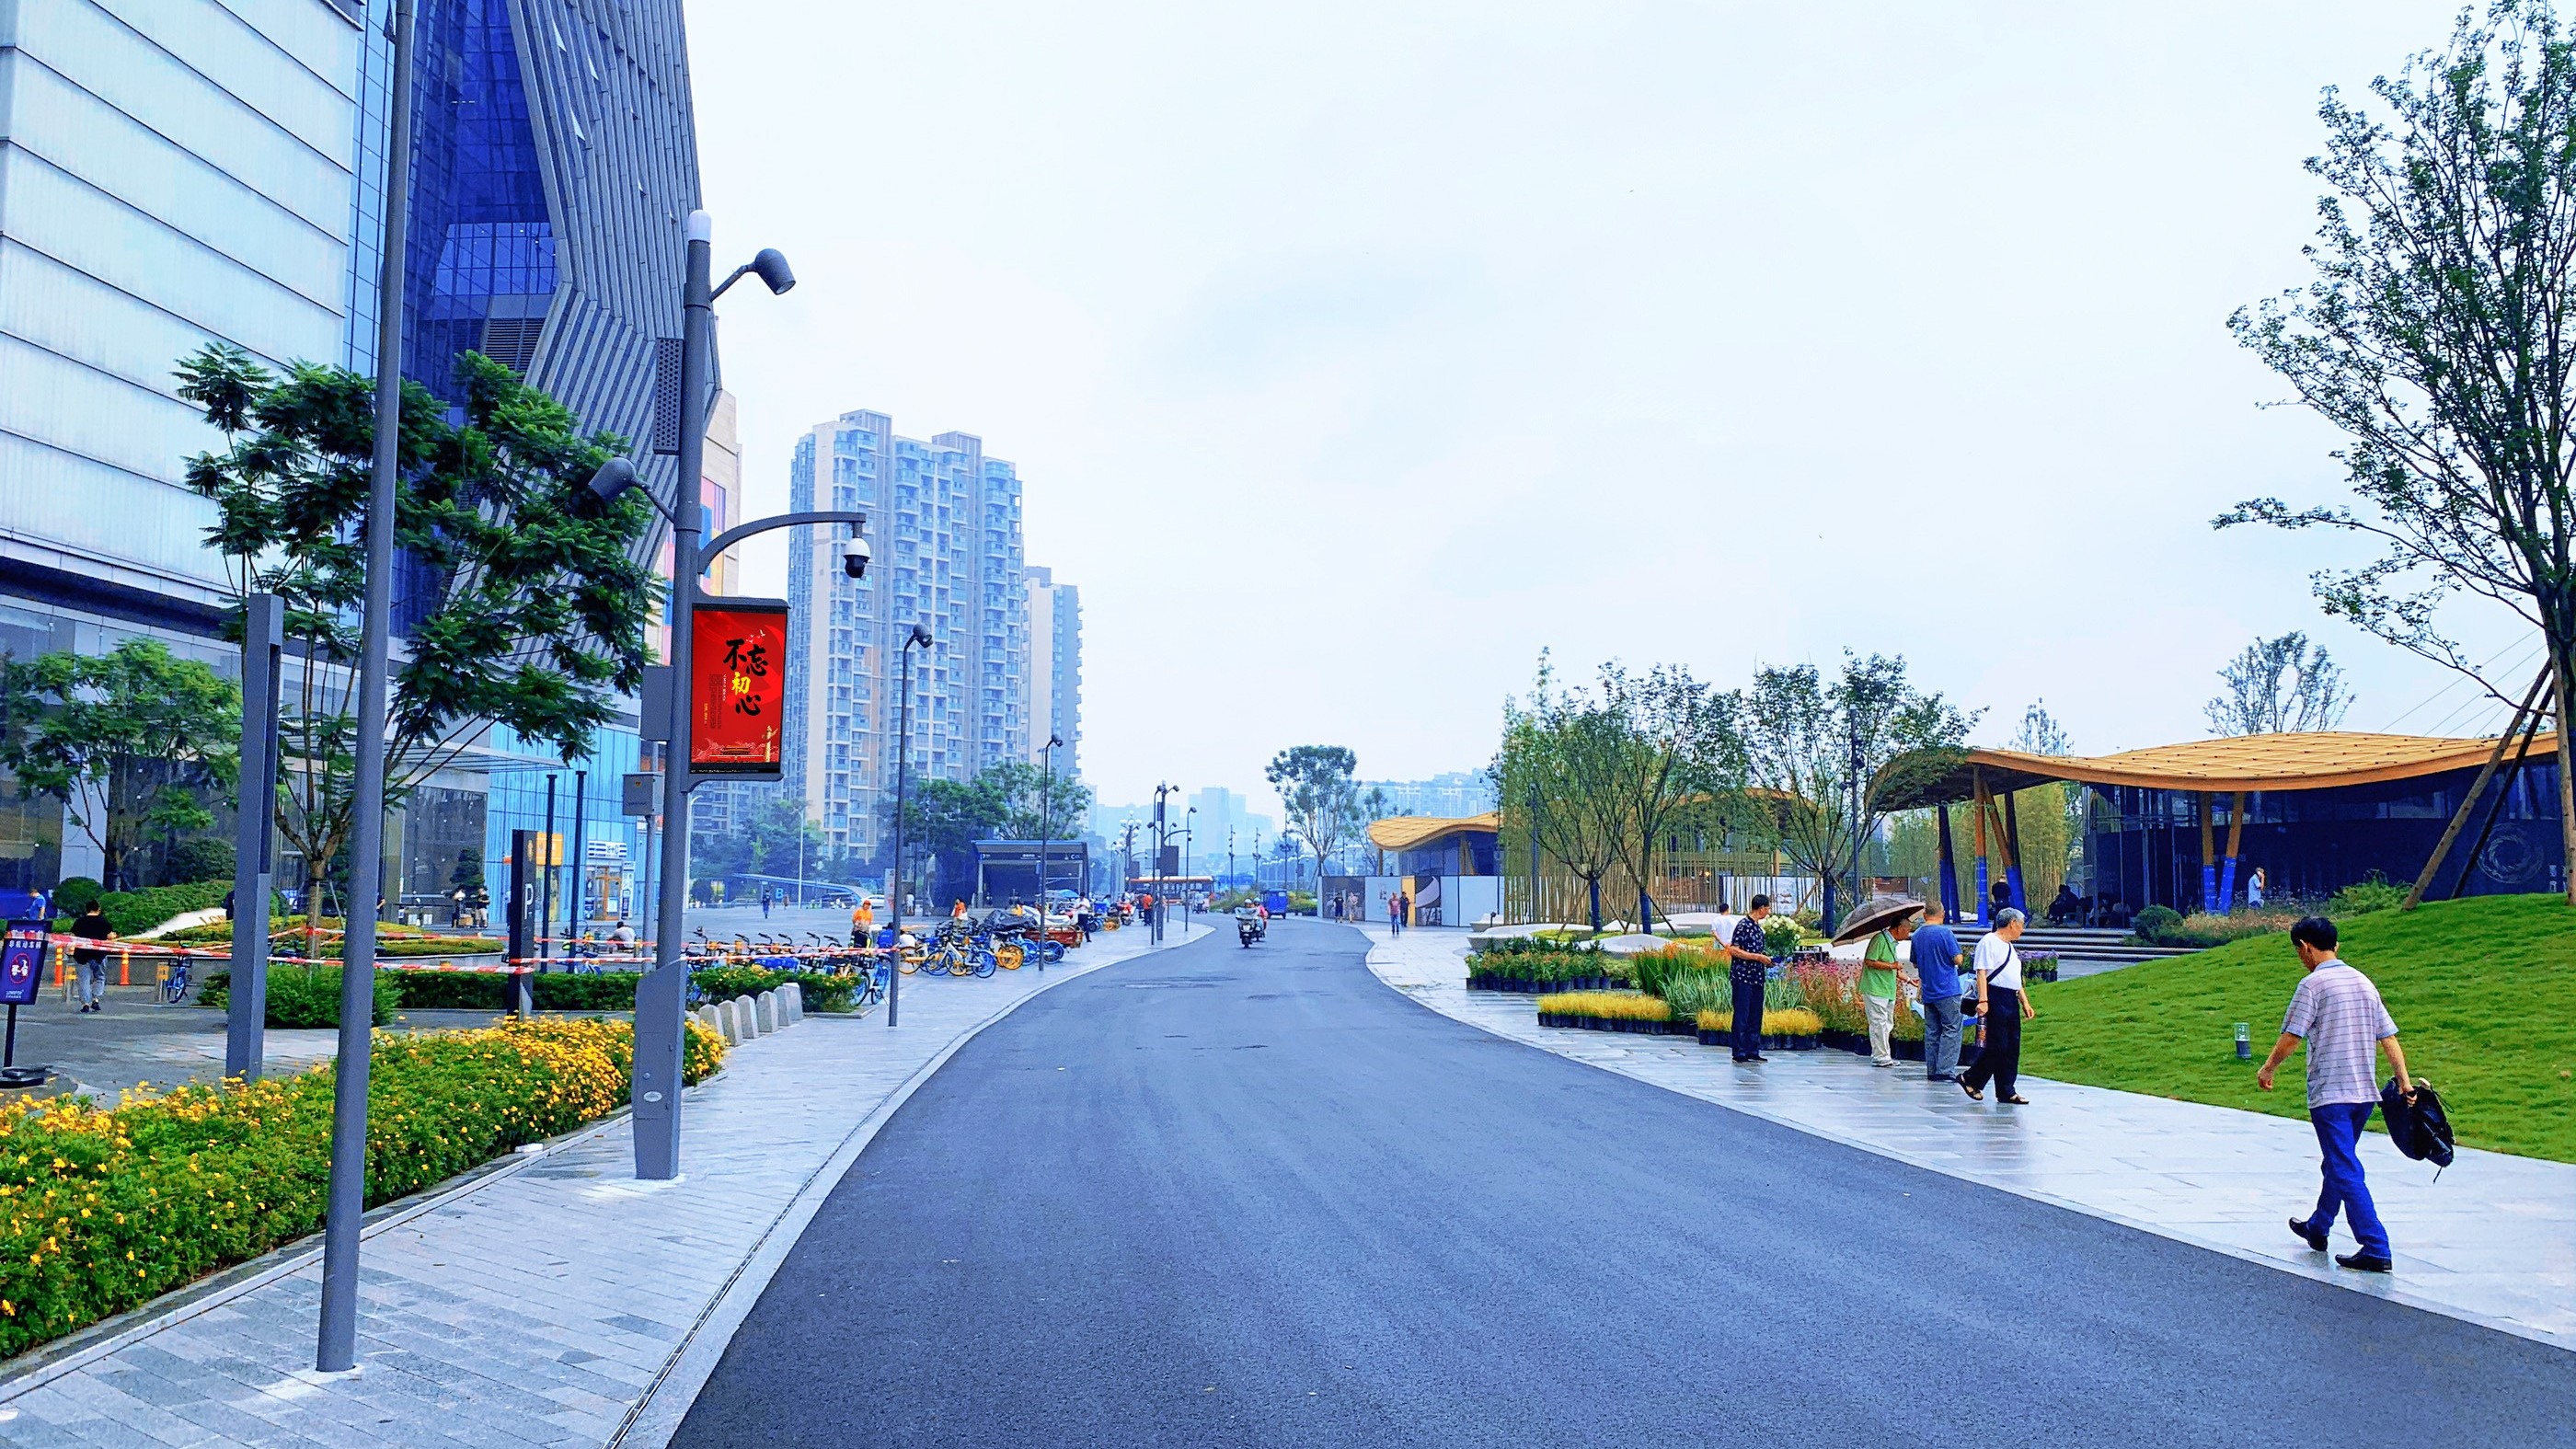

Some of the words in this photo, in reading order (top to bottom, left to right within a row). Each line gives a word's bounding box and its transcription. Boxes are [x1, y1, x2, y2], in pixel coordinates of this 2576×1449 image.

[723, 638, 768, 716] 不忘初心
[523, 882, 534, 920] P
[776, 888, 784, 899] B
